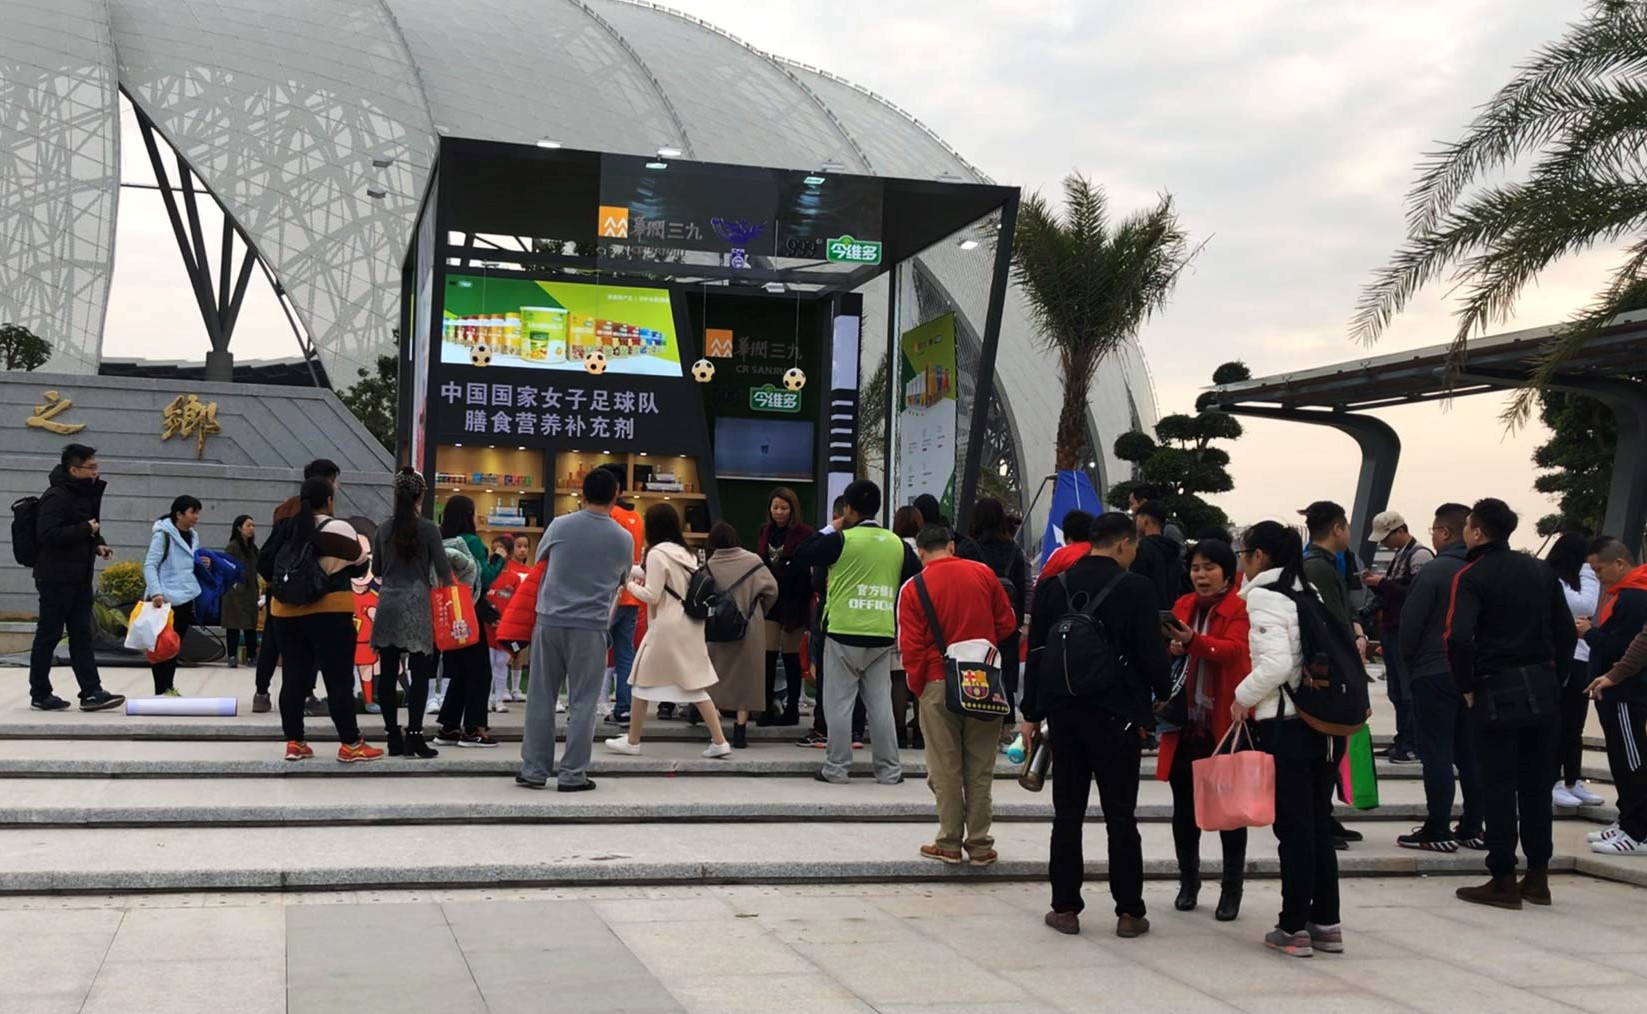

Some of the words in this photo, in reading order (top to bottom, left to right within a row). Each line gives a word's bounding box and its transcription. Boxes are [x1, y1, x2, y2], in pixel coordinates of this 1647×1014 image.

[830, 243, 878, 261] 今维多
[440, 380, 660, 414] 中国国家女子足球队
[753, 391, 798, 409] 今维多
[464, 409, 636, 440] 膳食营养补充剂
